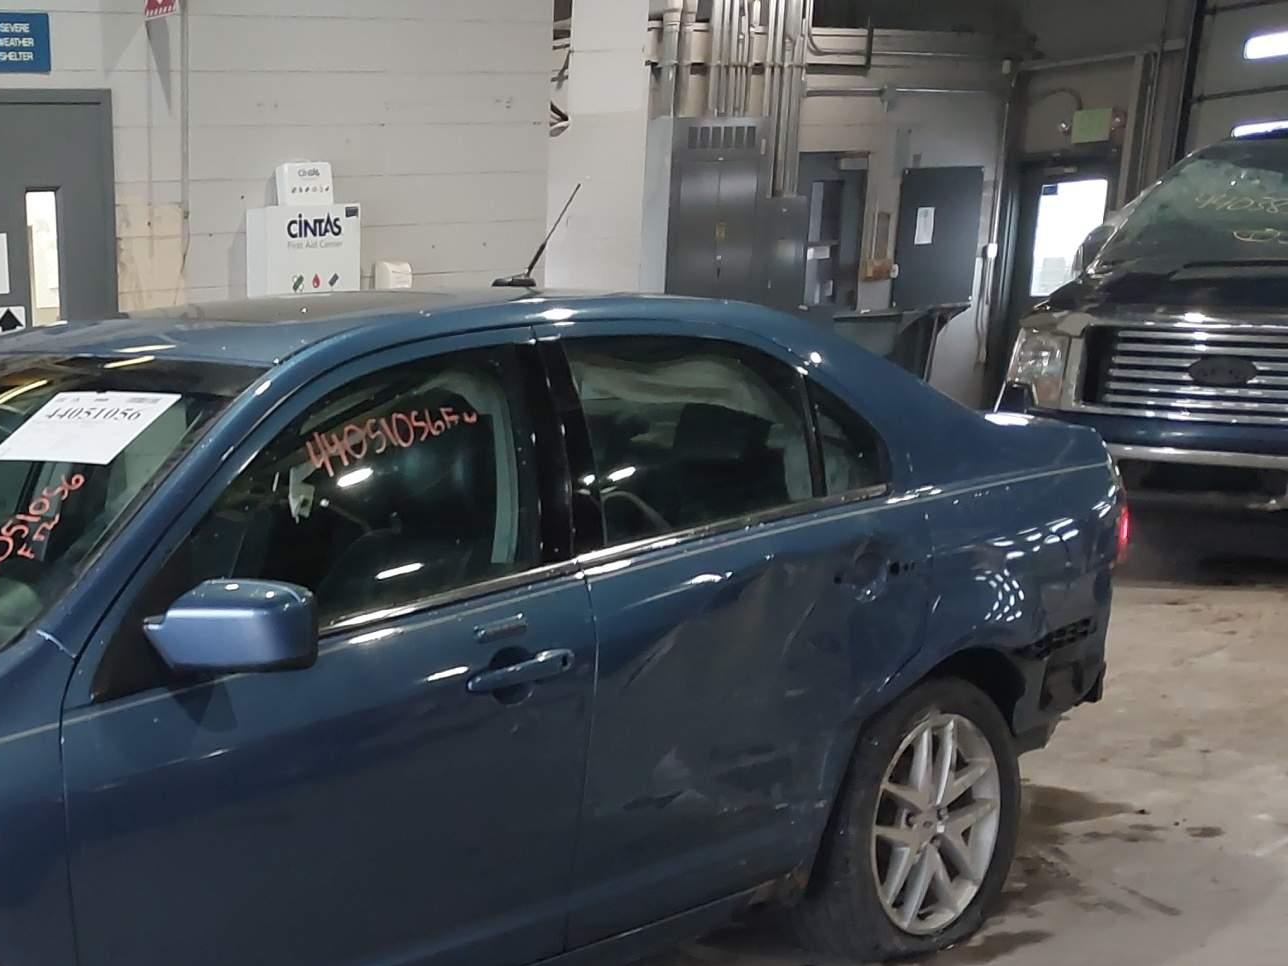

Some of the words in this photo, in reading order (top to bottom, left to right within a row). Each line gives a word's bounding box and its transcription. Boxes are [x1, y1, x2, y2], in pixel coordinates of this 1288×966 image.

[0, 22, 30, 33] SEVERE
[0, 51, 34, 61] SHELTER
[306, 240, 317, 249] Aid
[319, 240, 343, 249] Center
[46, 407, 142, 421] 44051056
